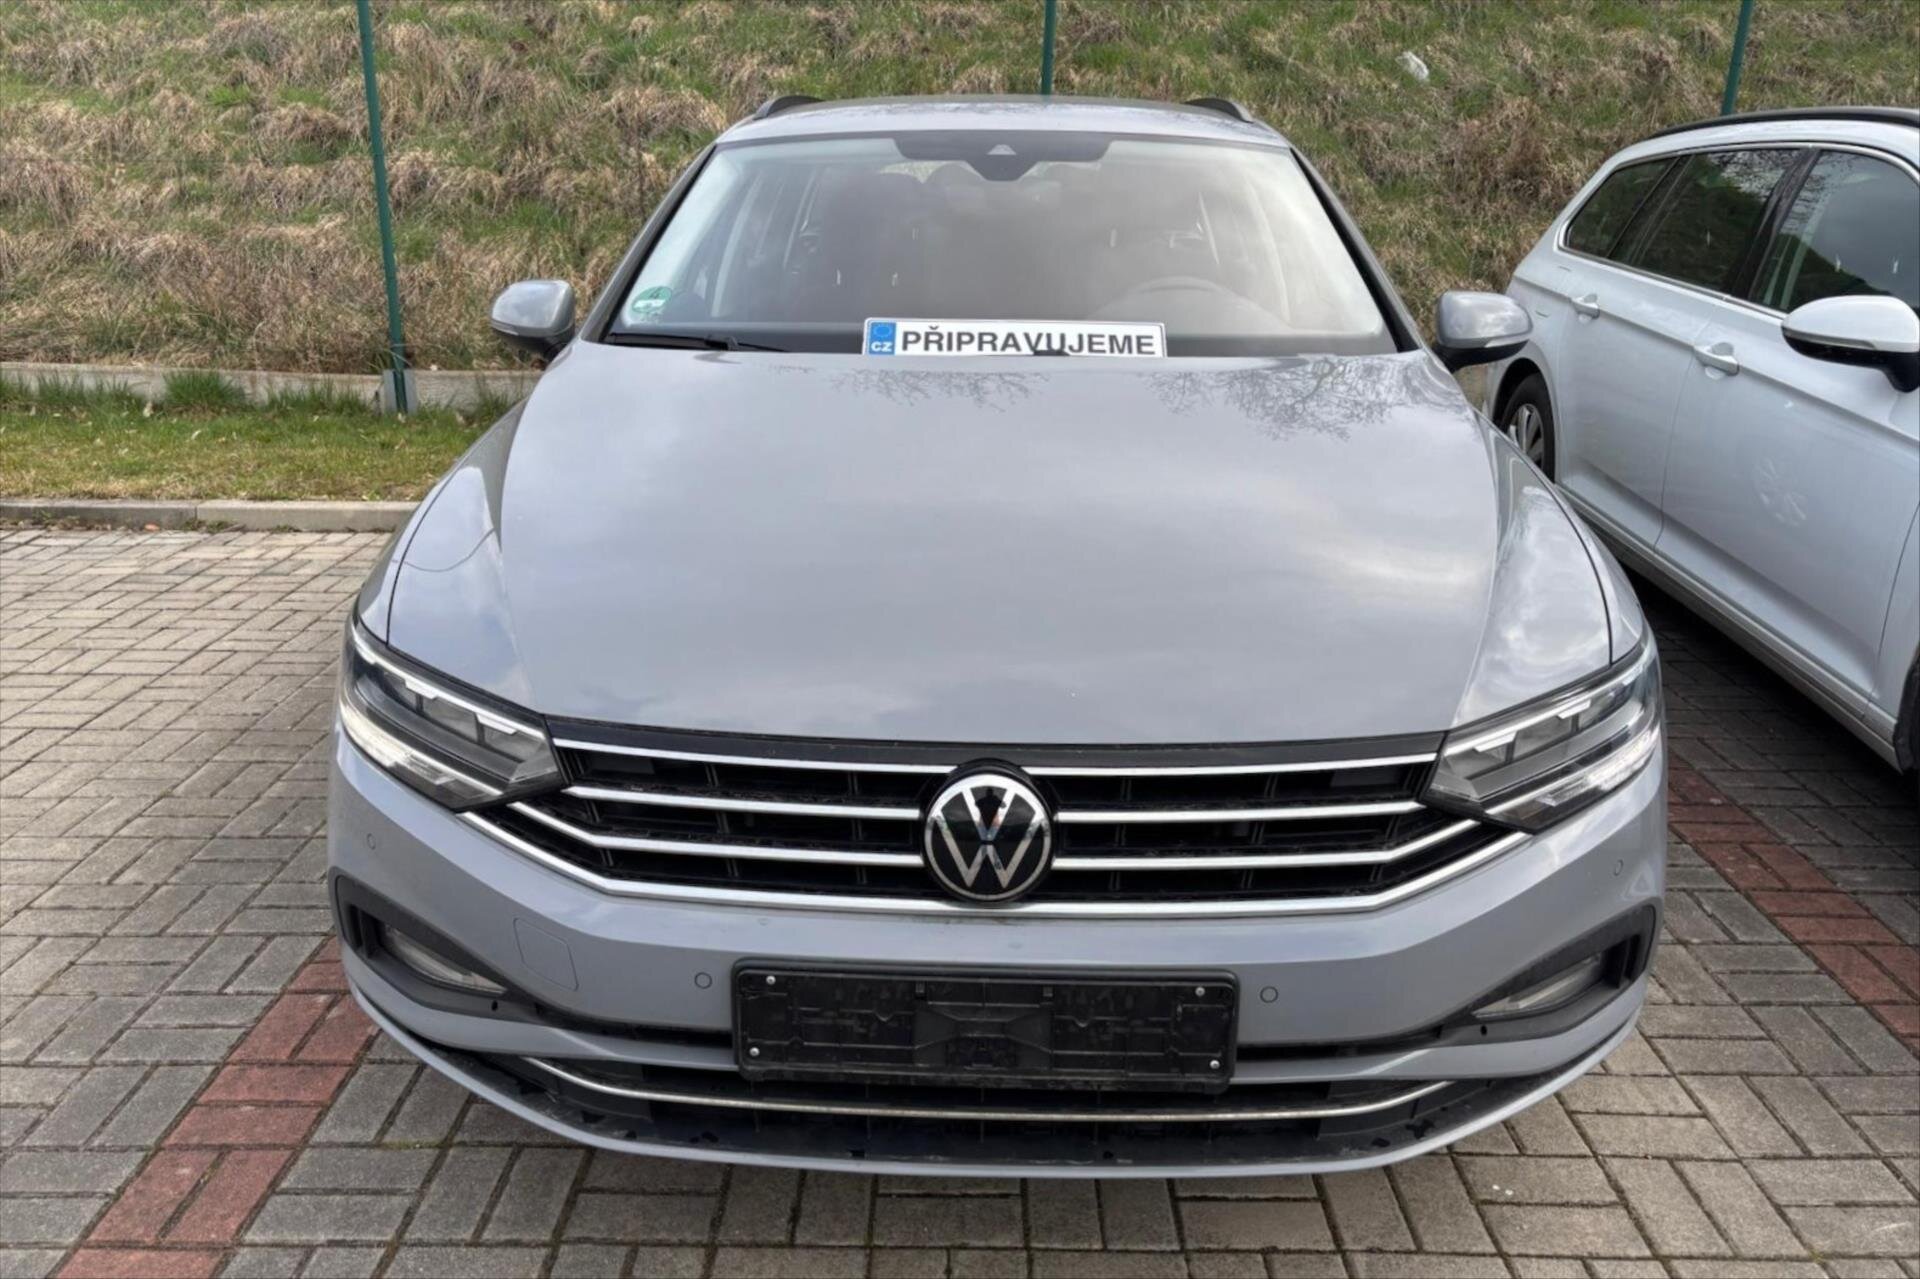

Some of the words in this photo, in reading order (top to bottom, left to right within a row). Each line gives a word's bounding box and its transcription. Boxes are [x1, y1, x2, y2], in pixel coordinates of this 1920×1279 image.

[870, 342, 892, 352] CZ
[902, 325, 1156, 355] PŘIPRAVUJEME
[928, 775, 1048, 892] VW
